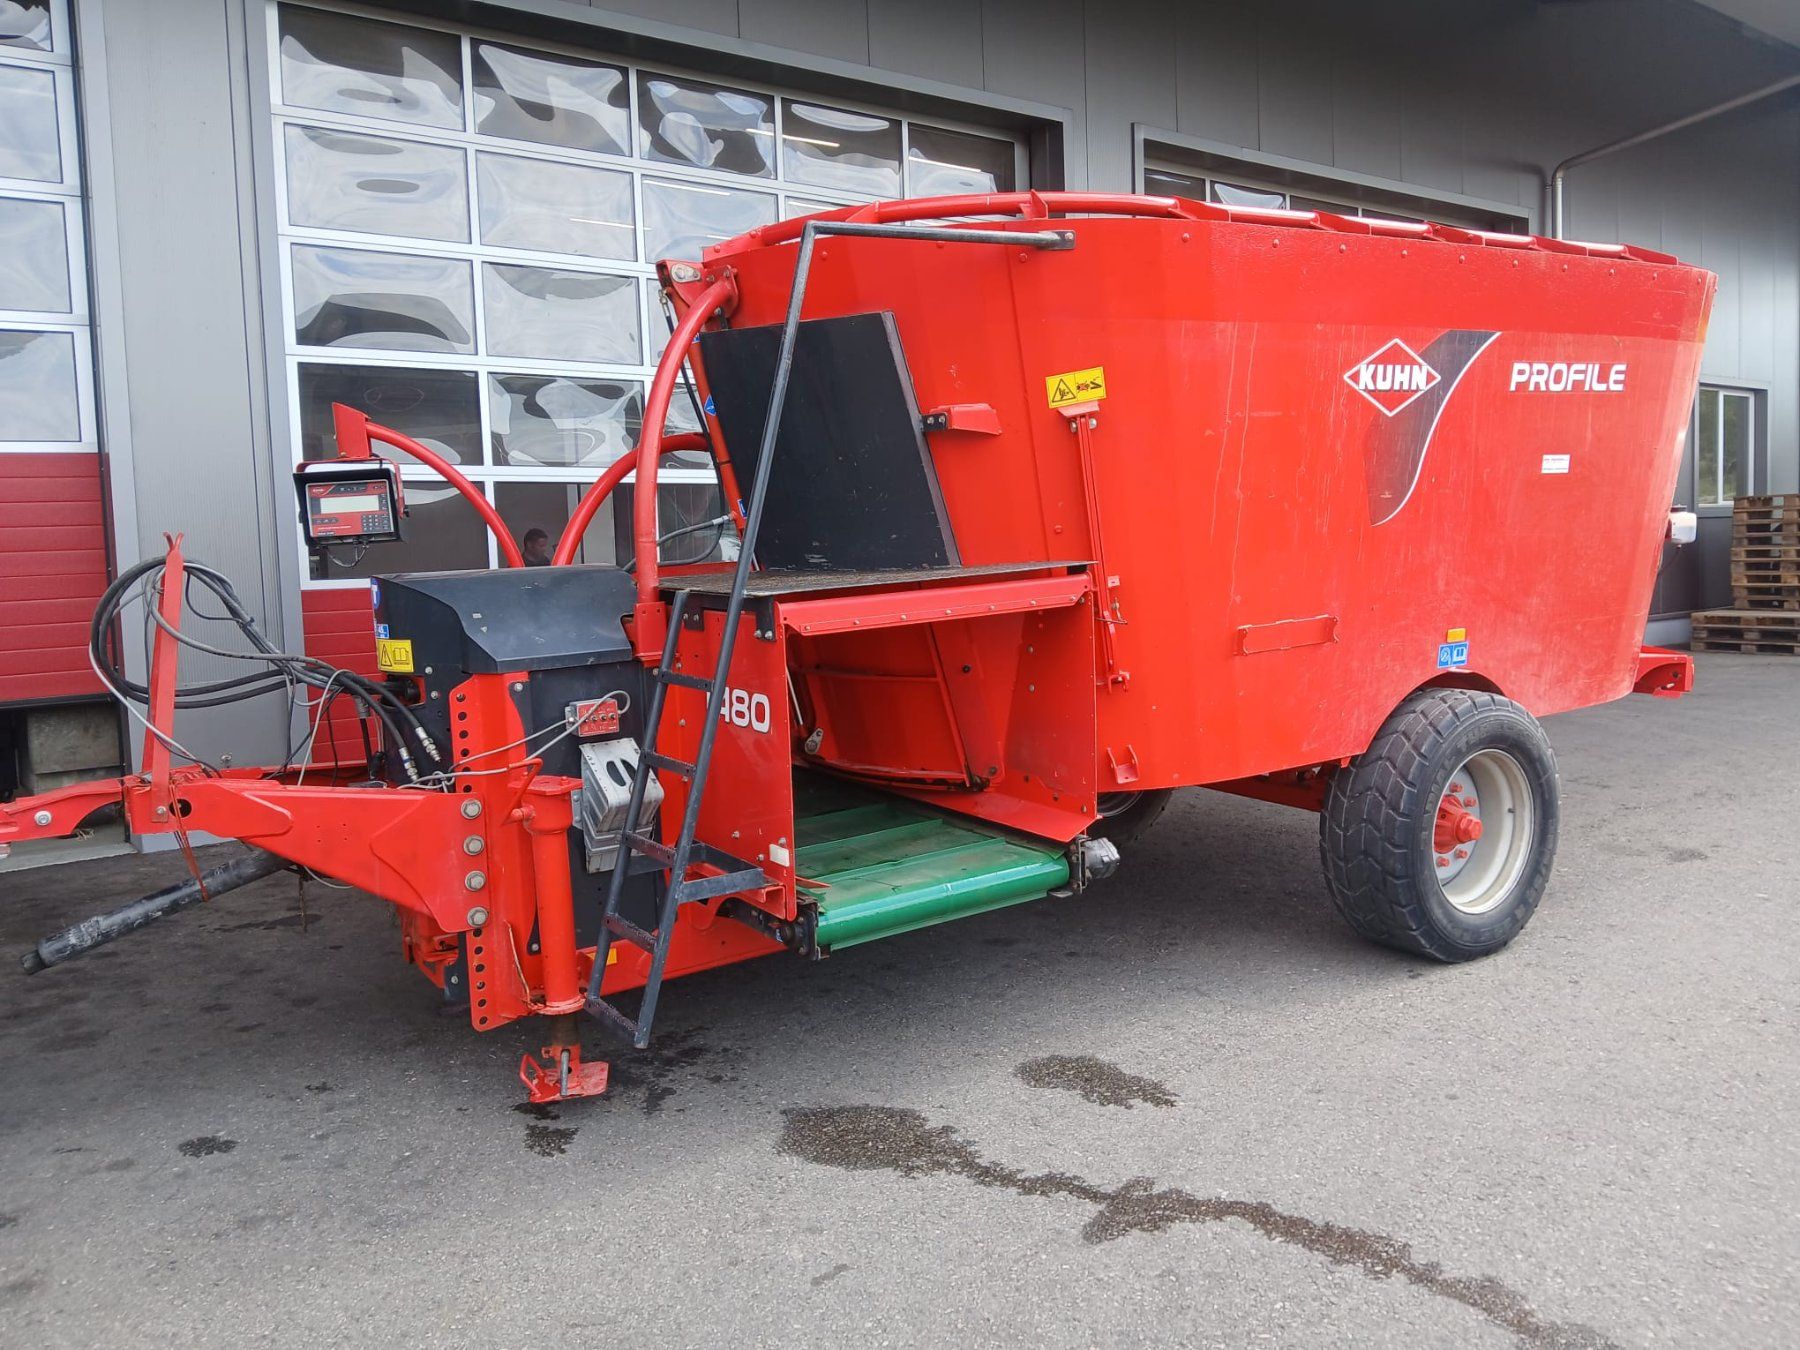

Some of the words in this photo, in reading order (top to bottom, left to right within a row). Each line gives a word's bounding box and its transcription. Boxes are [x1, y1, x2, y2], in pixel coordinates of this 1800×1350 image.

[1358, 363, 1428, 391] KUHN
[1509, 362, 1627, 392] PROFILE
[707, 686, 771, 733] 480
